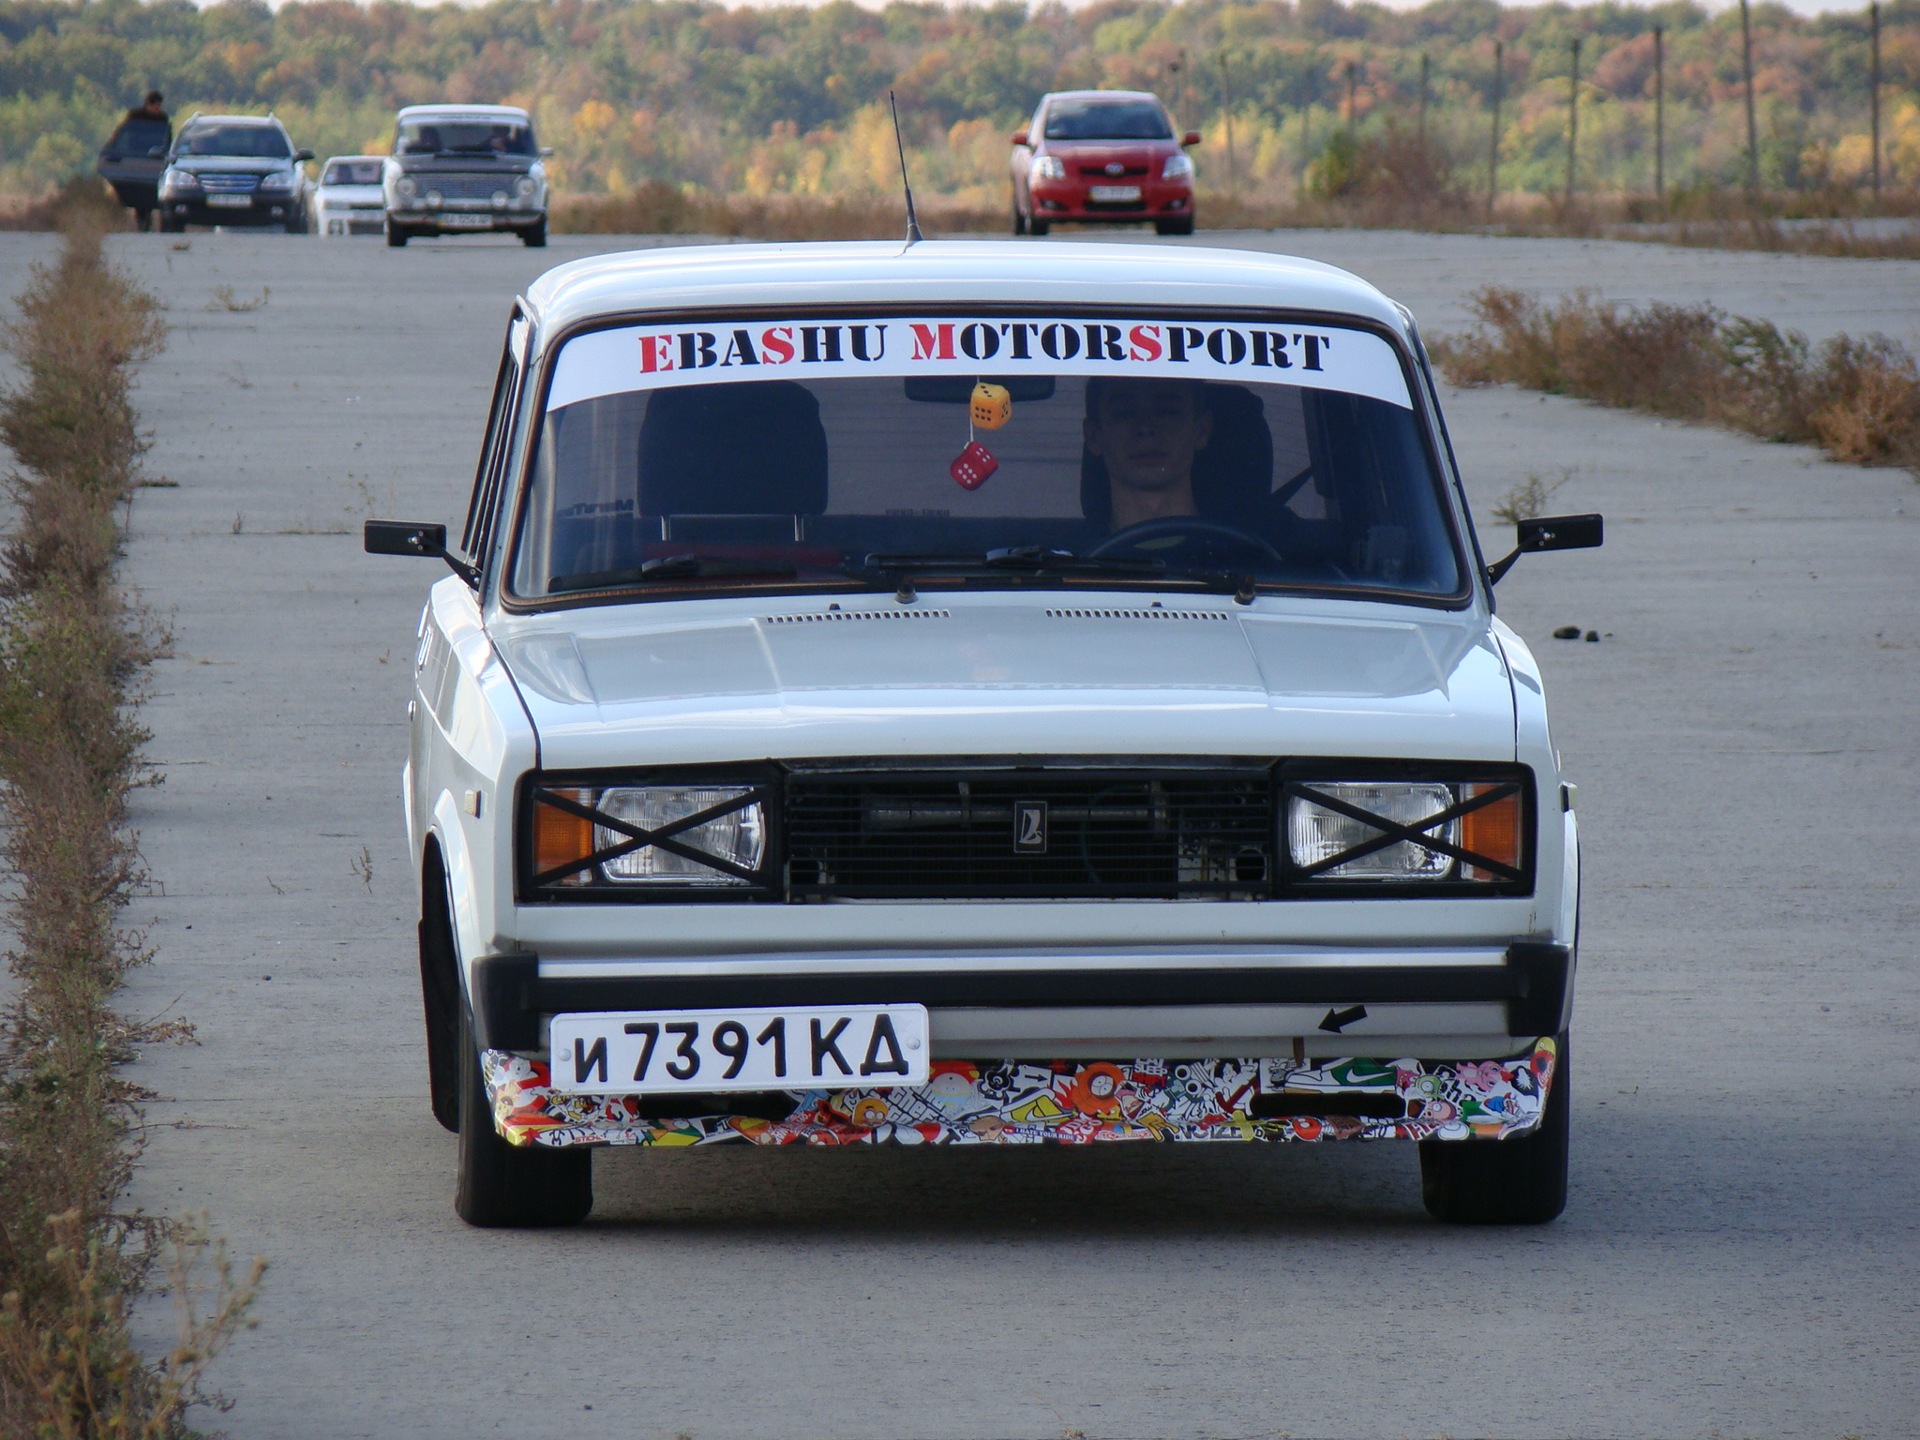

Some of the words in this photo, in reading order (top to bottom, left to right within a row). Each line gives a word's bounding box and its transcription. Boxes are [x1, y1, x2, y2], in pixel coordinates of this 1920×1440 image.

[638, 324, 888, 374] EBASHU
[909, 323, 1331, 372] MOTORSPORT
[623, 1016, 787, 1082] 7391
[809, 1013, 909, 1077] КД
